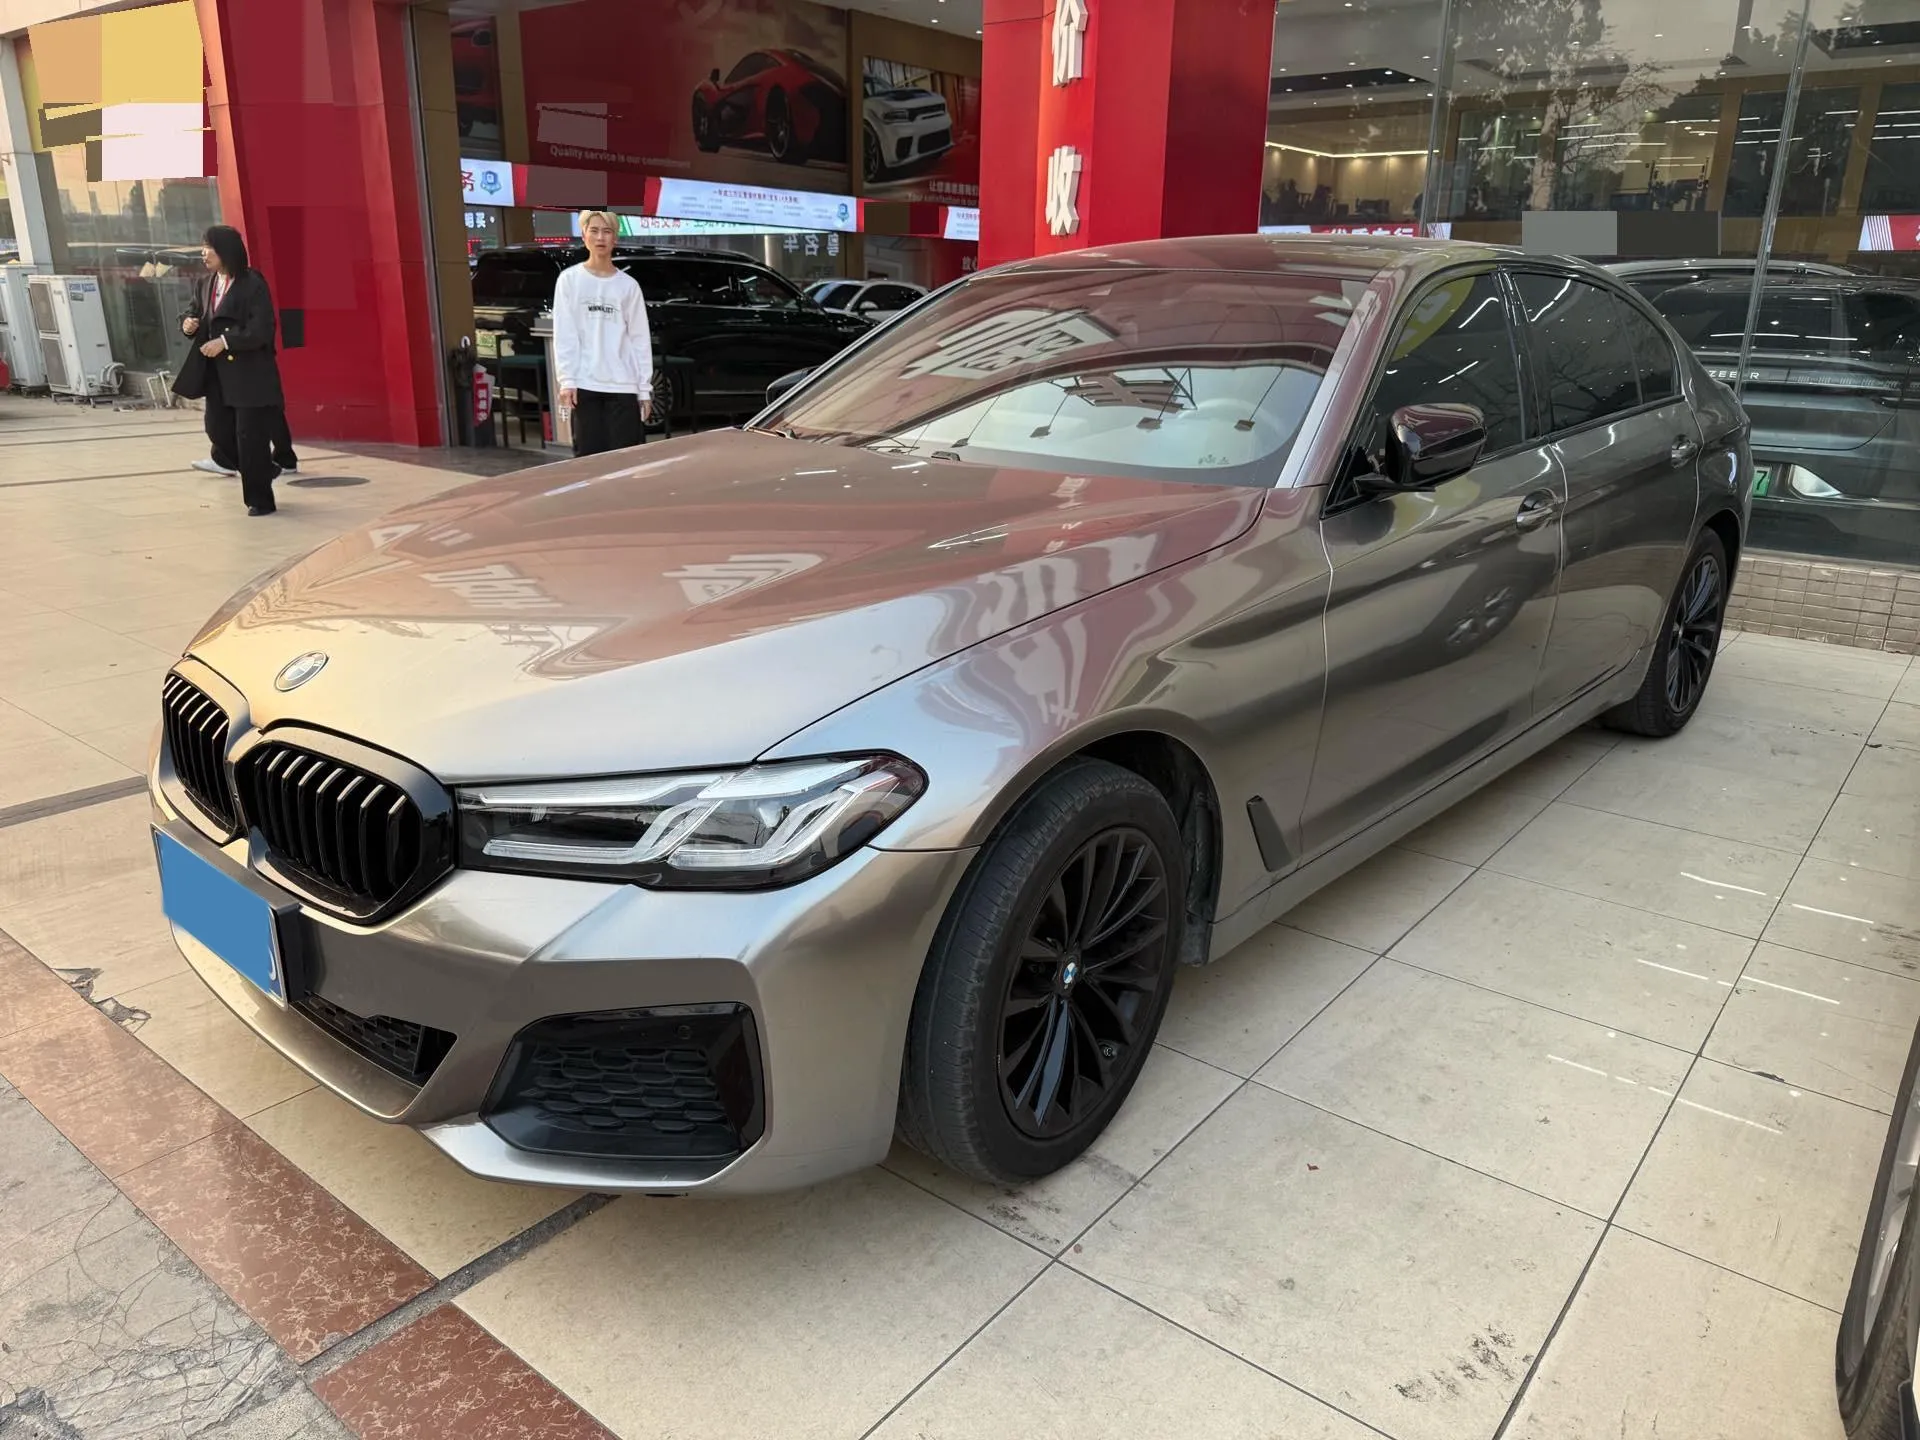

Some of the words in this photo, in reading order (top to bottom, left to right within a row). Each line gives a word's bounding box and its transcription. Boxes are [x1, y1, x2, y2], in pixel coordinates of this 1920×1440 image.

[550, 145, 582, 160] Quality
[584, 150, 616, 162] service
[617, 154, 625, 163] is
[1708, 370, 1760, 380] ZEER
[1756, 470, 1768, 491] 7
